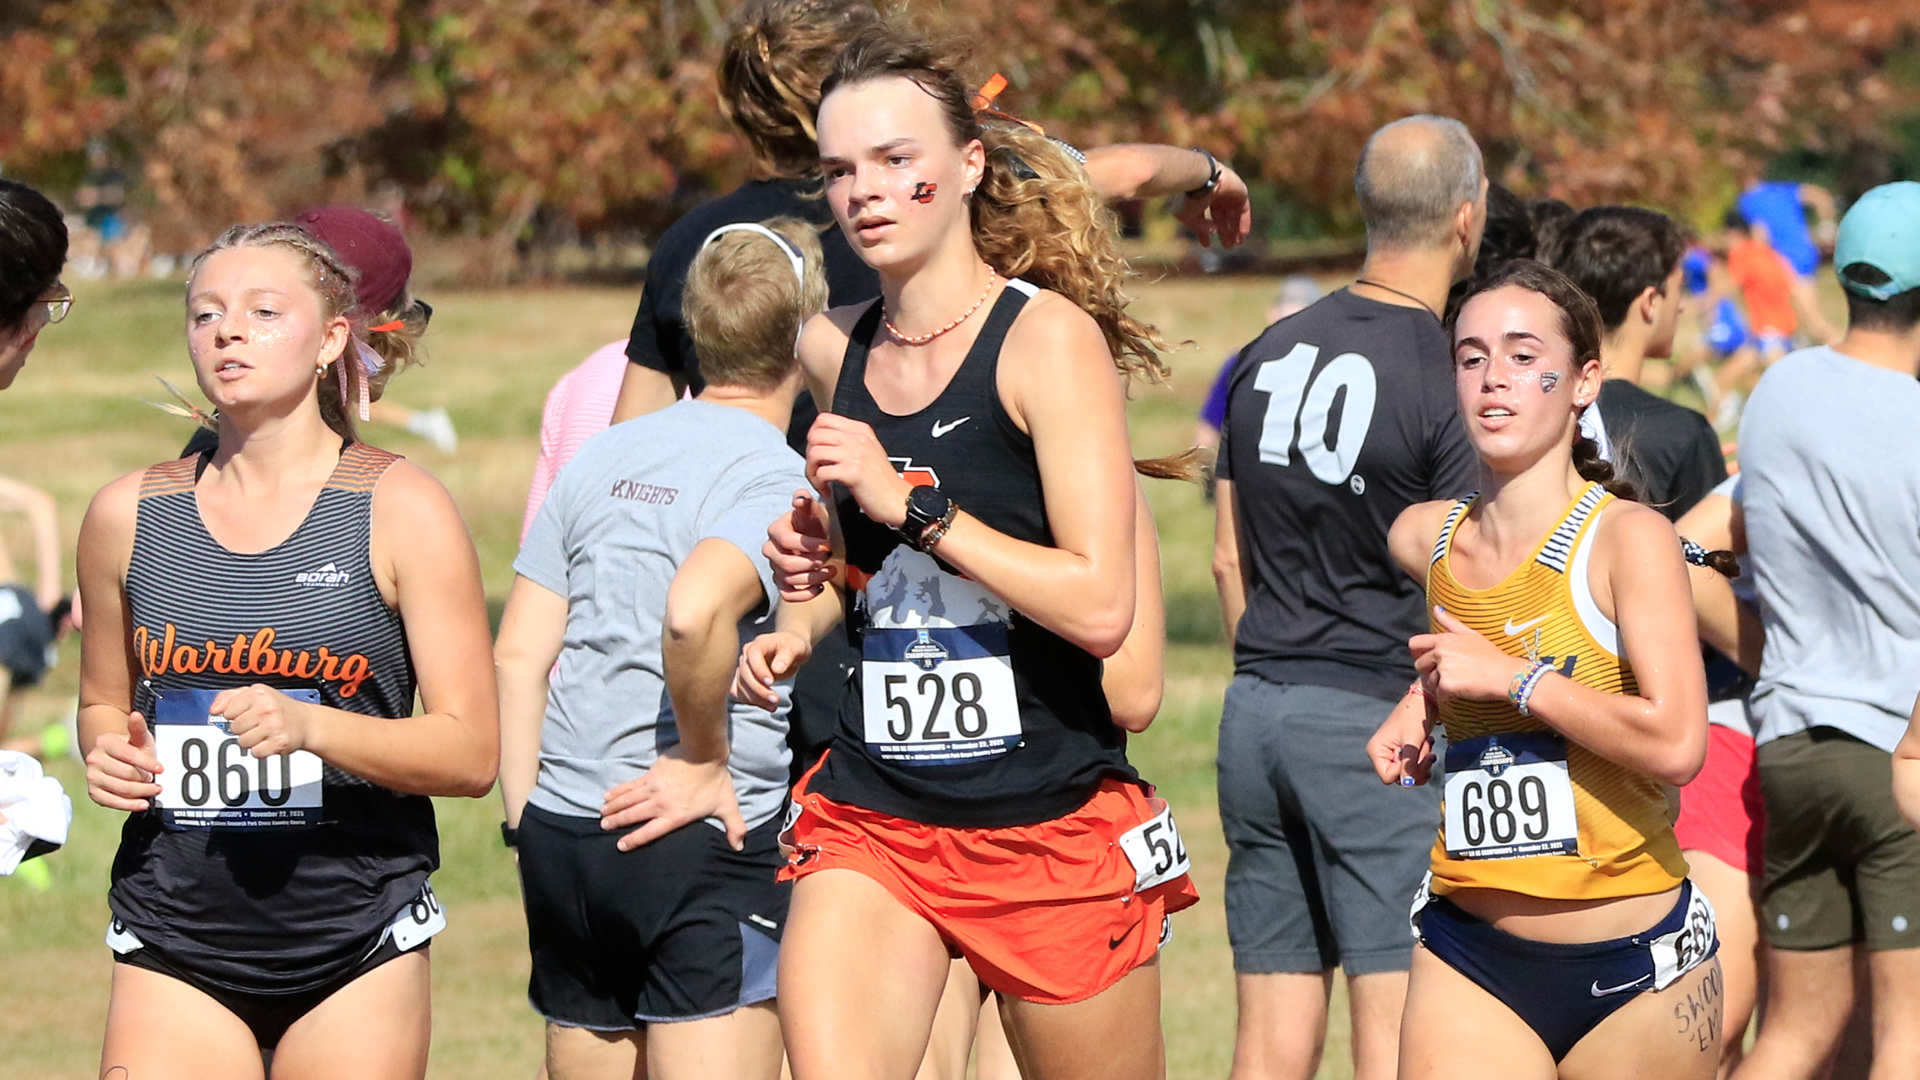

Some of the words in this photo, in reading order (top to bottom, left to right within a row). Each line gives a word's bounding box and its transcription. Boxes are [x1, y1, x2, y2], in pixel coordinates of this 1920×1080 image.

[1253, 342, 1377, 485] 10
[610, 479, 679, 505] KNIGHTS
[133, 623, 374, 698] Wartburg
[884, 672, 988, 741] 528
[181, 738, 292, 807] 860
[1462, 776, 1549, 846] 689
